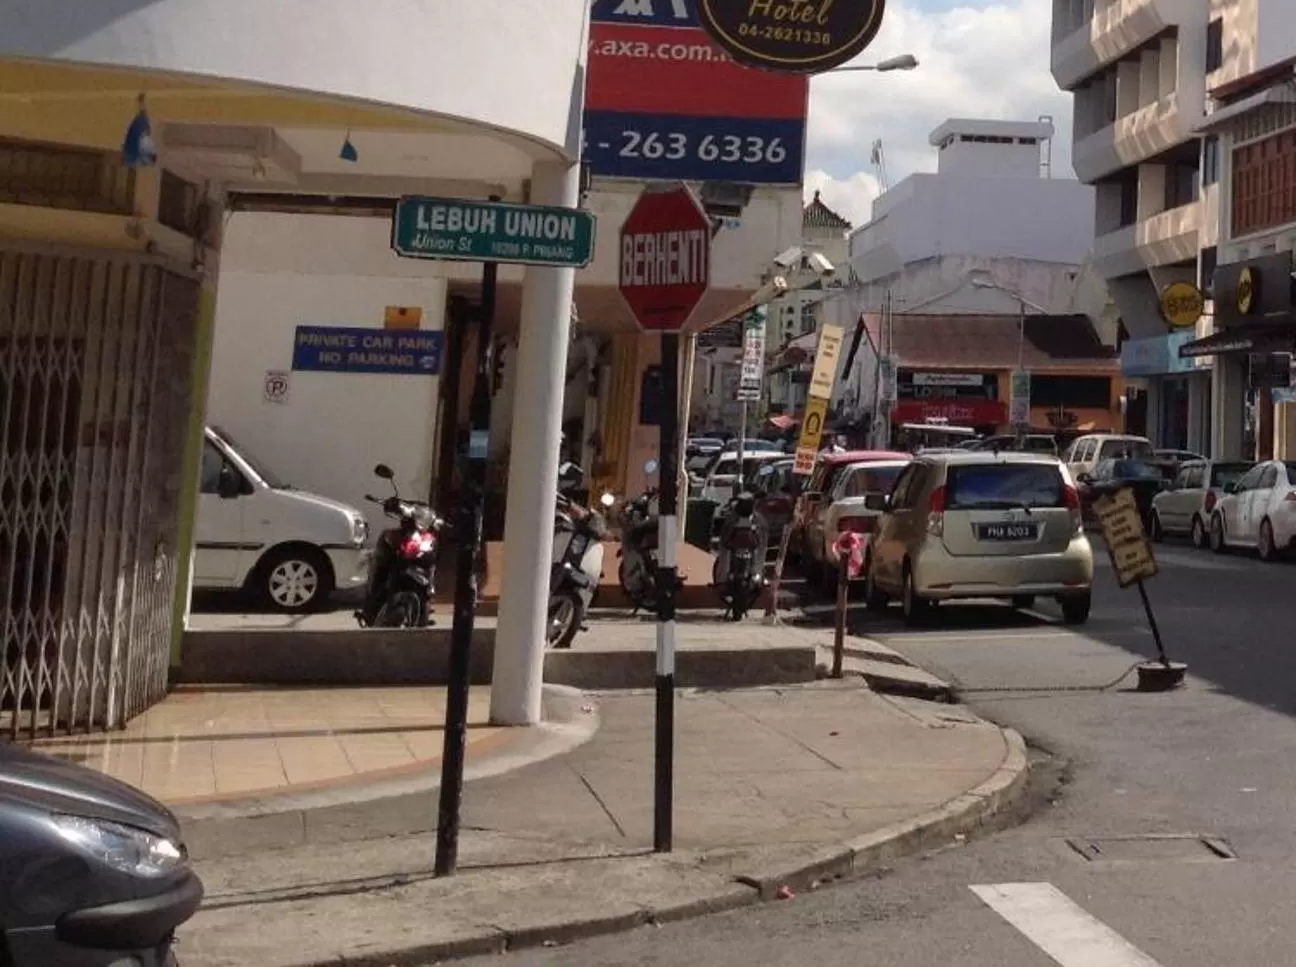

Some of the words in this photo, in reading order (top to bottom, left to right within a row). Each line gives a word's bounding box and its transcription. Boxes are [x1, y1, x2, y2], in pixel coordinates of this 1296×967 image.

[588, 39, 734, 63] .axa.com.
[619, 130, 687, 160] 263
[697, 135, 788, 164] 6336
[416, 204, 497, 234] LEBUH
[504, 211, 577, 241] UNION
[411, 232, 455, 251] Union
[458, 237, 473, 252] St
[621, 229, 706, 287] BERHENTI
[299, 333, 357, 349] PRIVATE
[362, 335, 395, 350] CAR
[399, 336, 438, 351] PARK
[319, 351, 342, 364] NO
[347, 352, 415, 368] PARKING
